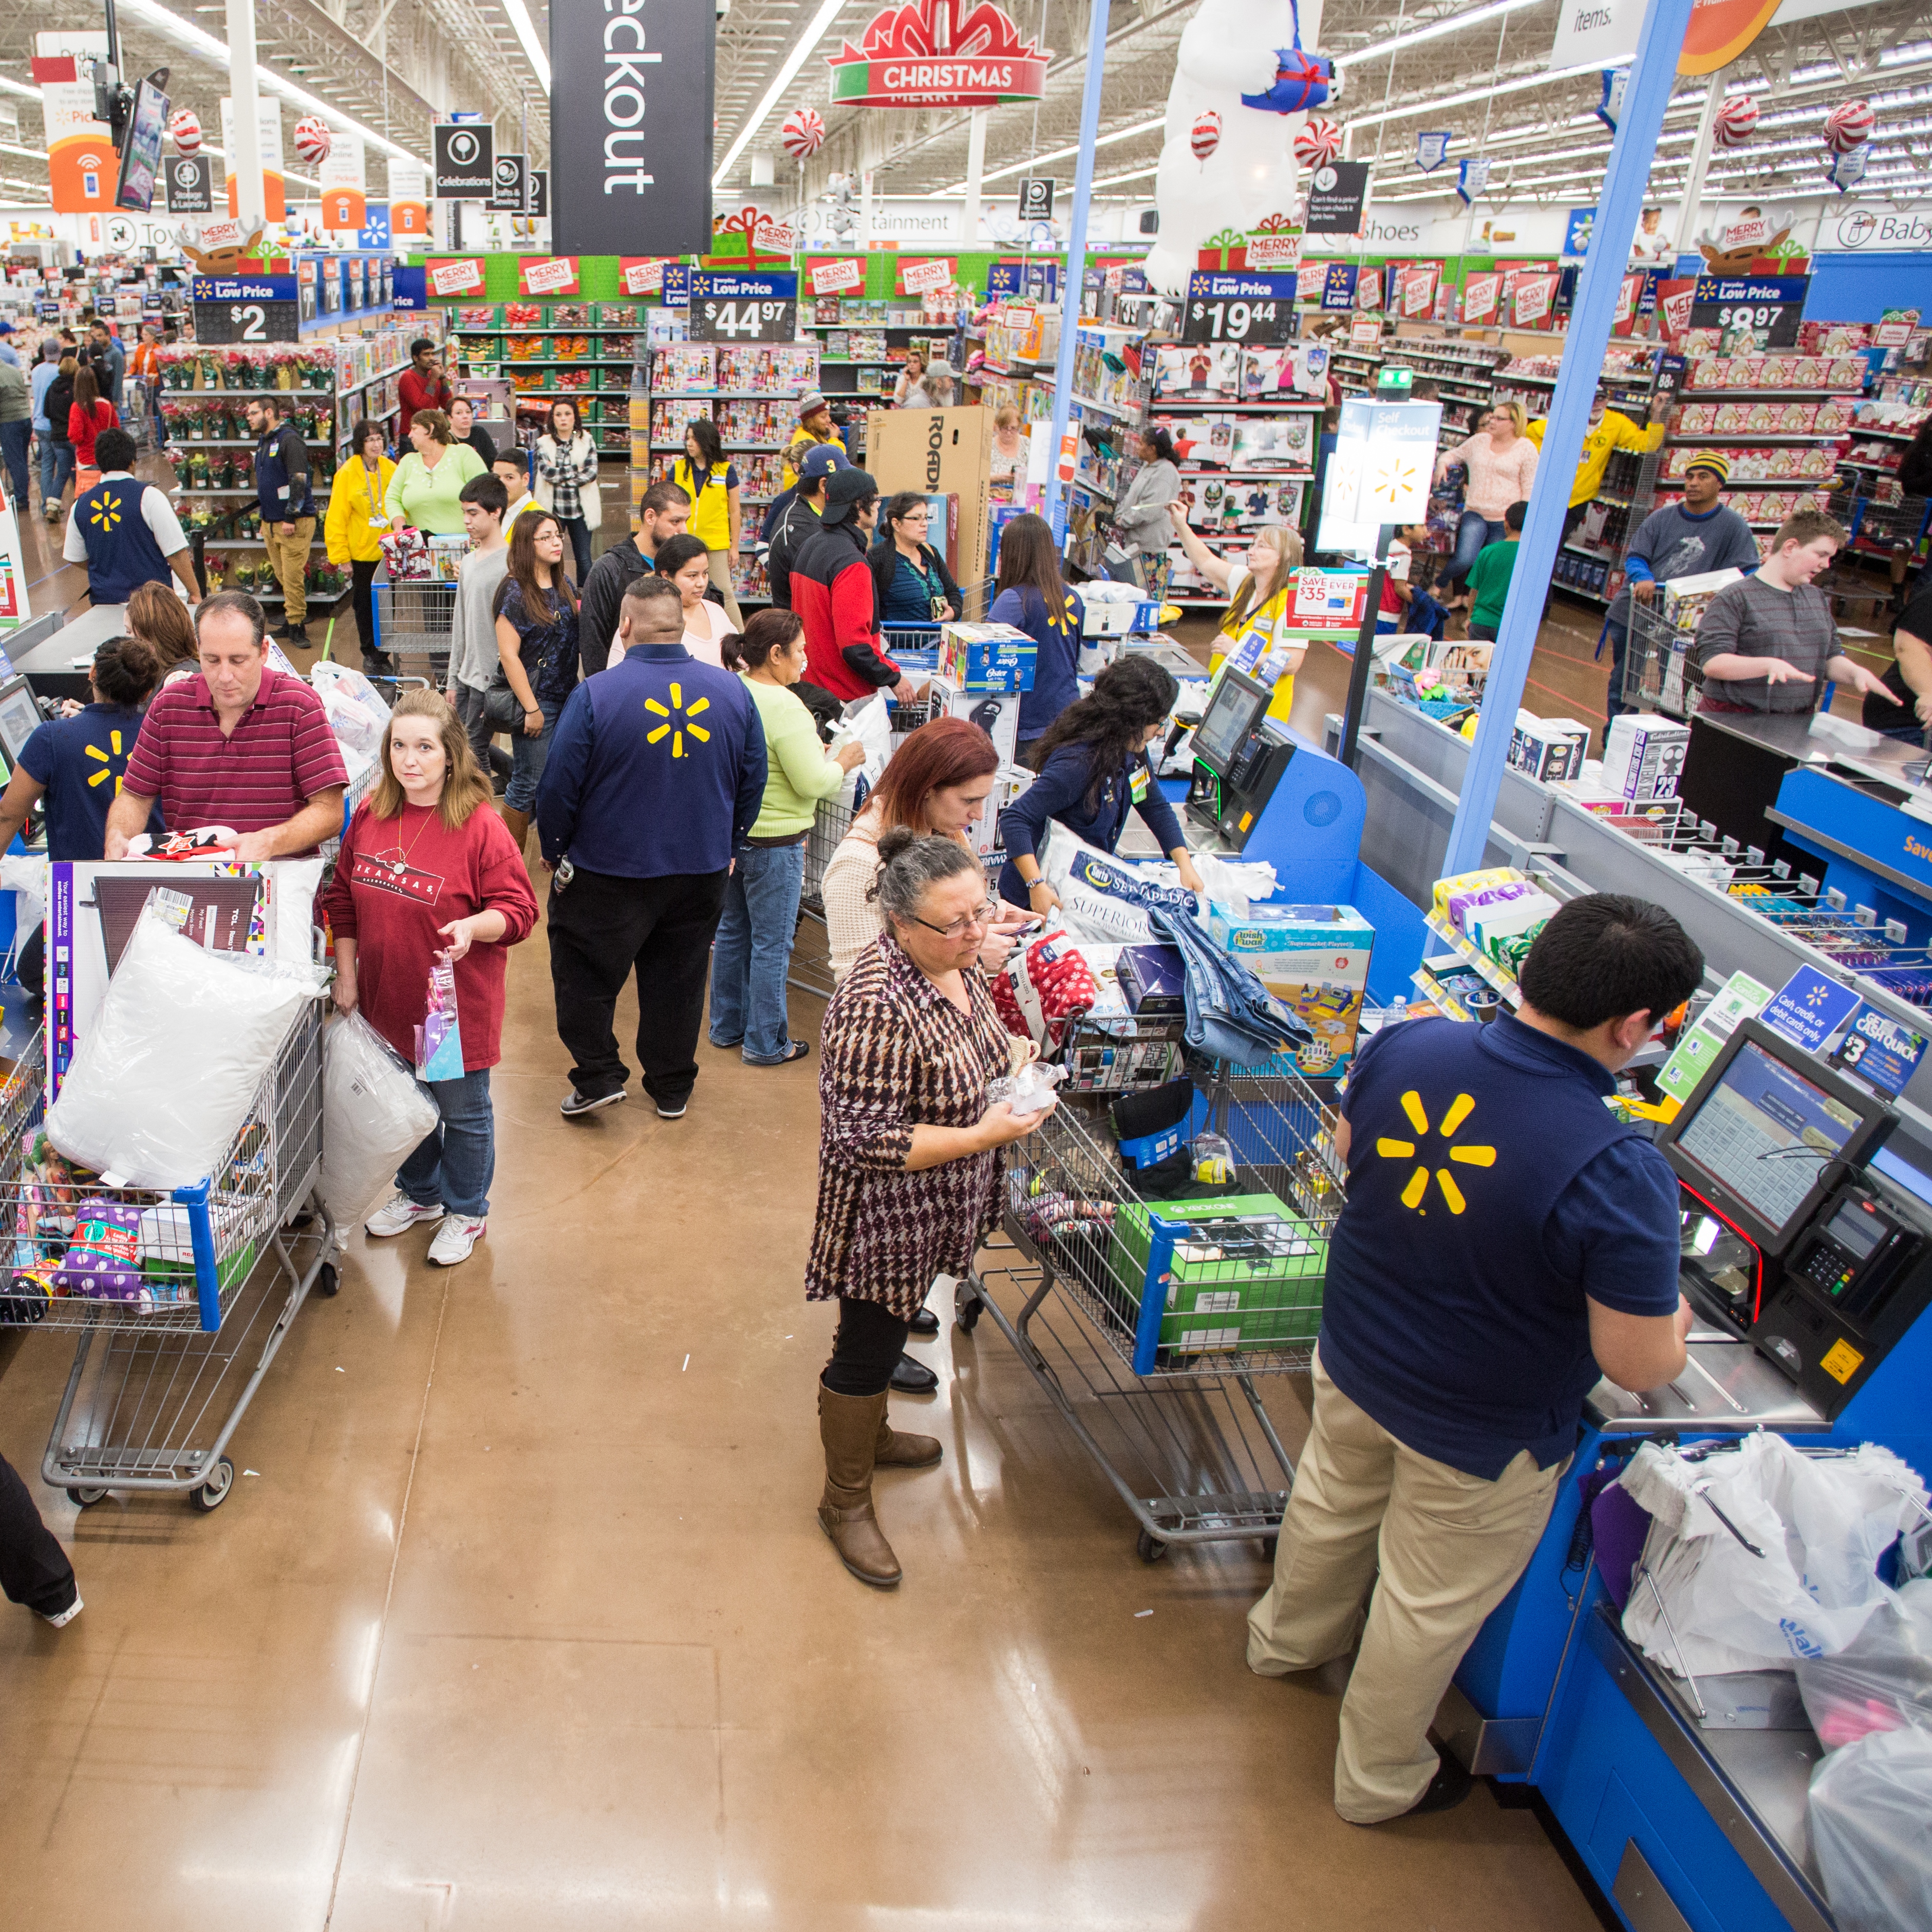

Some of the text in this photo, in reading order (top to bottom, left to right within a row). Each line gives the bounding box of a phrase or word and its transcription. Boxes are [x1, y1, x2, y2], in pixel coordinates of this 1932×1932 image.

[1573, 7, 1611, 33] items.
[884, 65, 1012, 89] CHRISTMAS
[437, 176, 492, 187] Celebrations
[174, 191, 203, 200] Storage
[1311, 196, 1325, 204] Can't
[1343, 196, 1359, 205] price?
[180, 200, 208, 210] Laundry
[494, 199, 520, 208] Sewing
[826, 213, 949, 230] Etainment
[1309, 213, 1321, 221] right
[202, 223, 236, 238] MERRY
[758, 226, 795, 241] MERRY
[1364, 220, 1419, 240] Shoes
[1725, 220, 1767, 237] MERRY
[141, 224, 183, 250] Toy
[203, 233, 239, 245] CHRISTMAS
[756, 235, 793, 248] CHRISTMAS
[1250, 237, 1301, 251] MERRY
[1725, 231, 1765, 245] CHRISTMAS
[1250, 250, 1298, 260] CHRISTMAS
[436, 263, 473, 282] MERRY
[528, 262, 565, 282] MERRY
[816, 264, 854, 280] MERRY
[906, 264, 945, 280] MERRY
[438, 274, 475, 288] CHRISTMAS
[531, 273, 568, 287] CHRISTMAS
[817, 275, 855, 287] CHRISTMAS
[908, 275, 946, 287] CHRISTMAS
[215, 285, 274, 298] Low Price
[713, 283, 773, 295] Low Price
[1212, 282, 1272, 295] Low Price
[1468, 284, 1496, 302] MERRY
[1518, 286, 1547, 304] MERRY
[1719, 287, 1780, 299] Low Price
[393, 296, 414, 306] rice
[666, 295, 688, 305] Low
[1326, 295, 1347, 306] Low
[1377, 412, 1399, 424] Self
[1376, 423, 1430, 436] Checkout
[826, 459, 836, 473] 3
[1302, 576, 1328, 587] SAVE
[1329, 582, 1355, 590] EVER
[1300, 587, 1326, 601] $35
[997, 657, 1018, 667] Oster
[986, 668, 1008, 678] Oster
[1655, 776, 1678, 799] 23
[354, 864, 433, 895] RKANSAS
[1091, 865, 1109, 883] Serta
[363, 876, 403, 894] RAZORBACKS
[231, 908, 239, 926] TCL
[1070, 896, 1148, 934] SUPERIOR
[1239, 929, 1263, 940] wish
[1732, 981, 1762, 1003] Scan&Go
[1778, 995, 1825, 1027] Cash, credit, or
[1769, 1004, 1822, 1043] debit cards only.
[1865, 1011, 1886, 1029] GET
[1855, 1017, 1884, 1044] CASH
[1844, 1036, 1867, 1063] $3
[1883, 1035, 1919, 1063] QUICK
[1213, 1203, 1237, 1211] ONE
